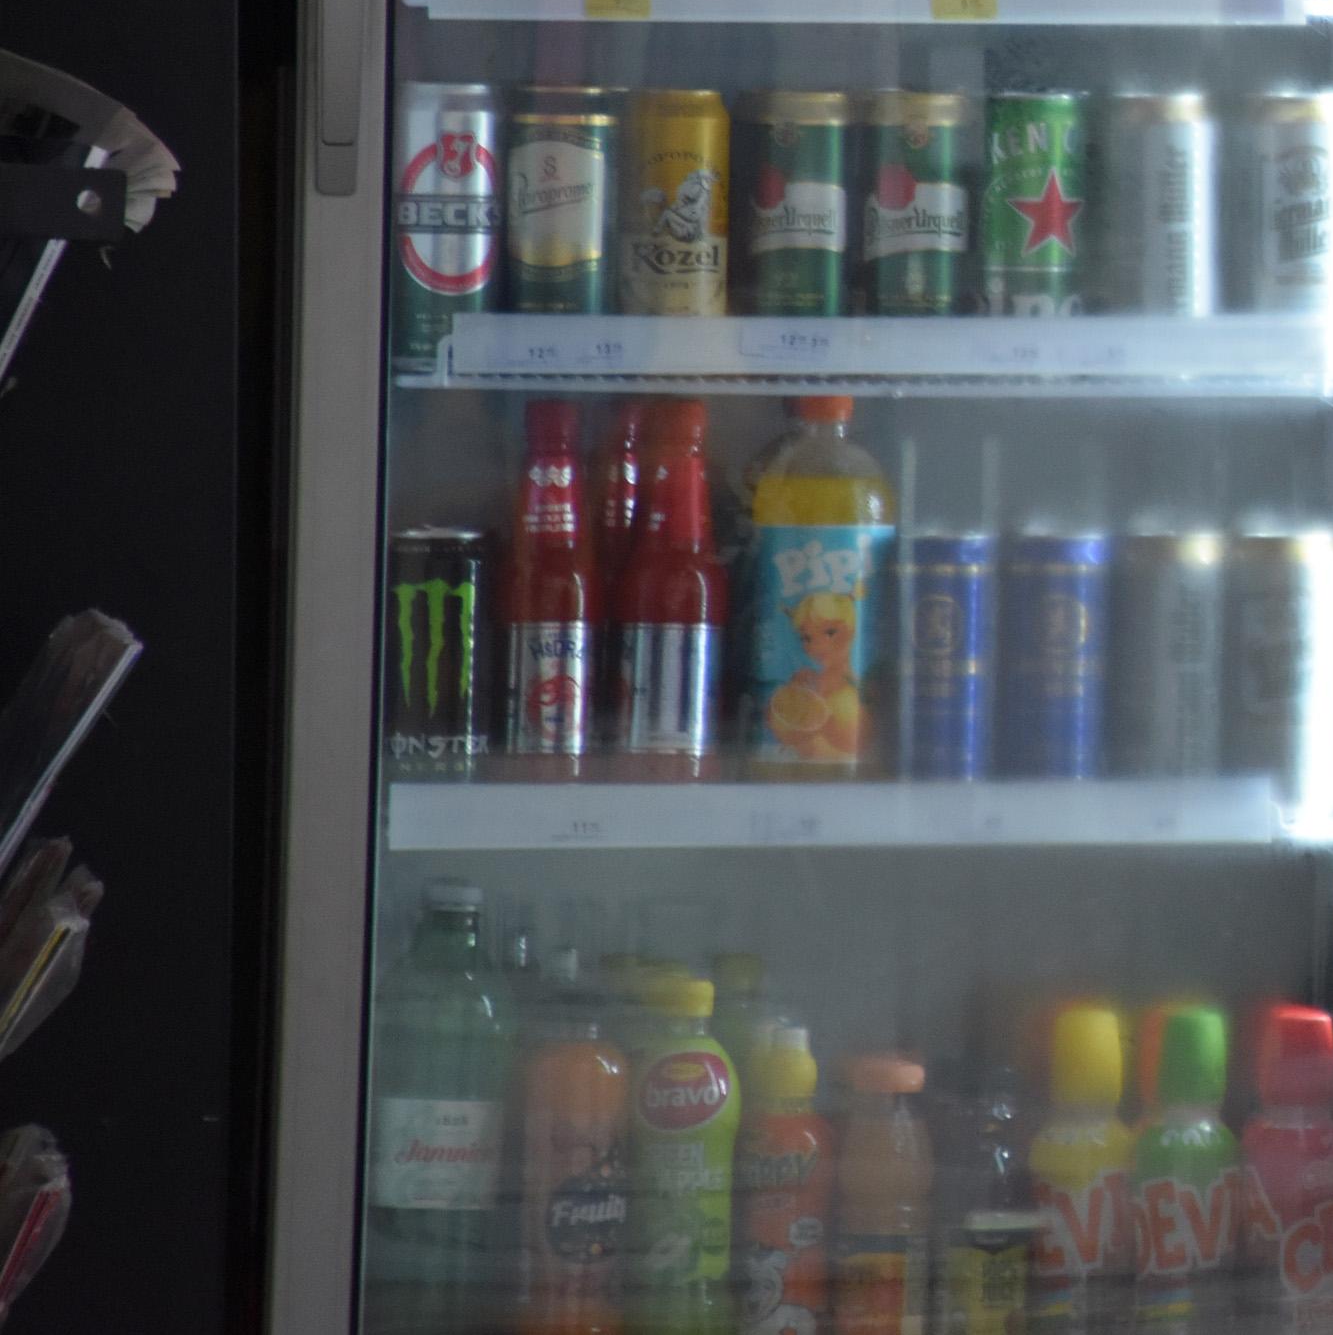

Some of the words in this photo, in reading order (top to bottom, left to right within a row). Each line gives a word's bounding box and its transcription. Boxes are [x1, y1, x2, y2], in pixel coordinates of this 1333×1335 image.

[630, 241, 721, 273] Kozel
[390, 735, 489, 759] ONSTER
[645, 1084, 722, 1108] bravo
